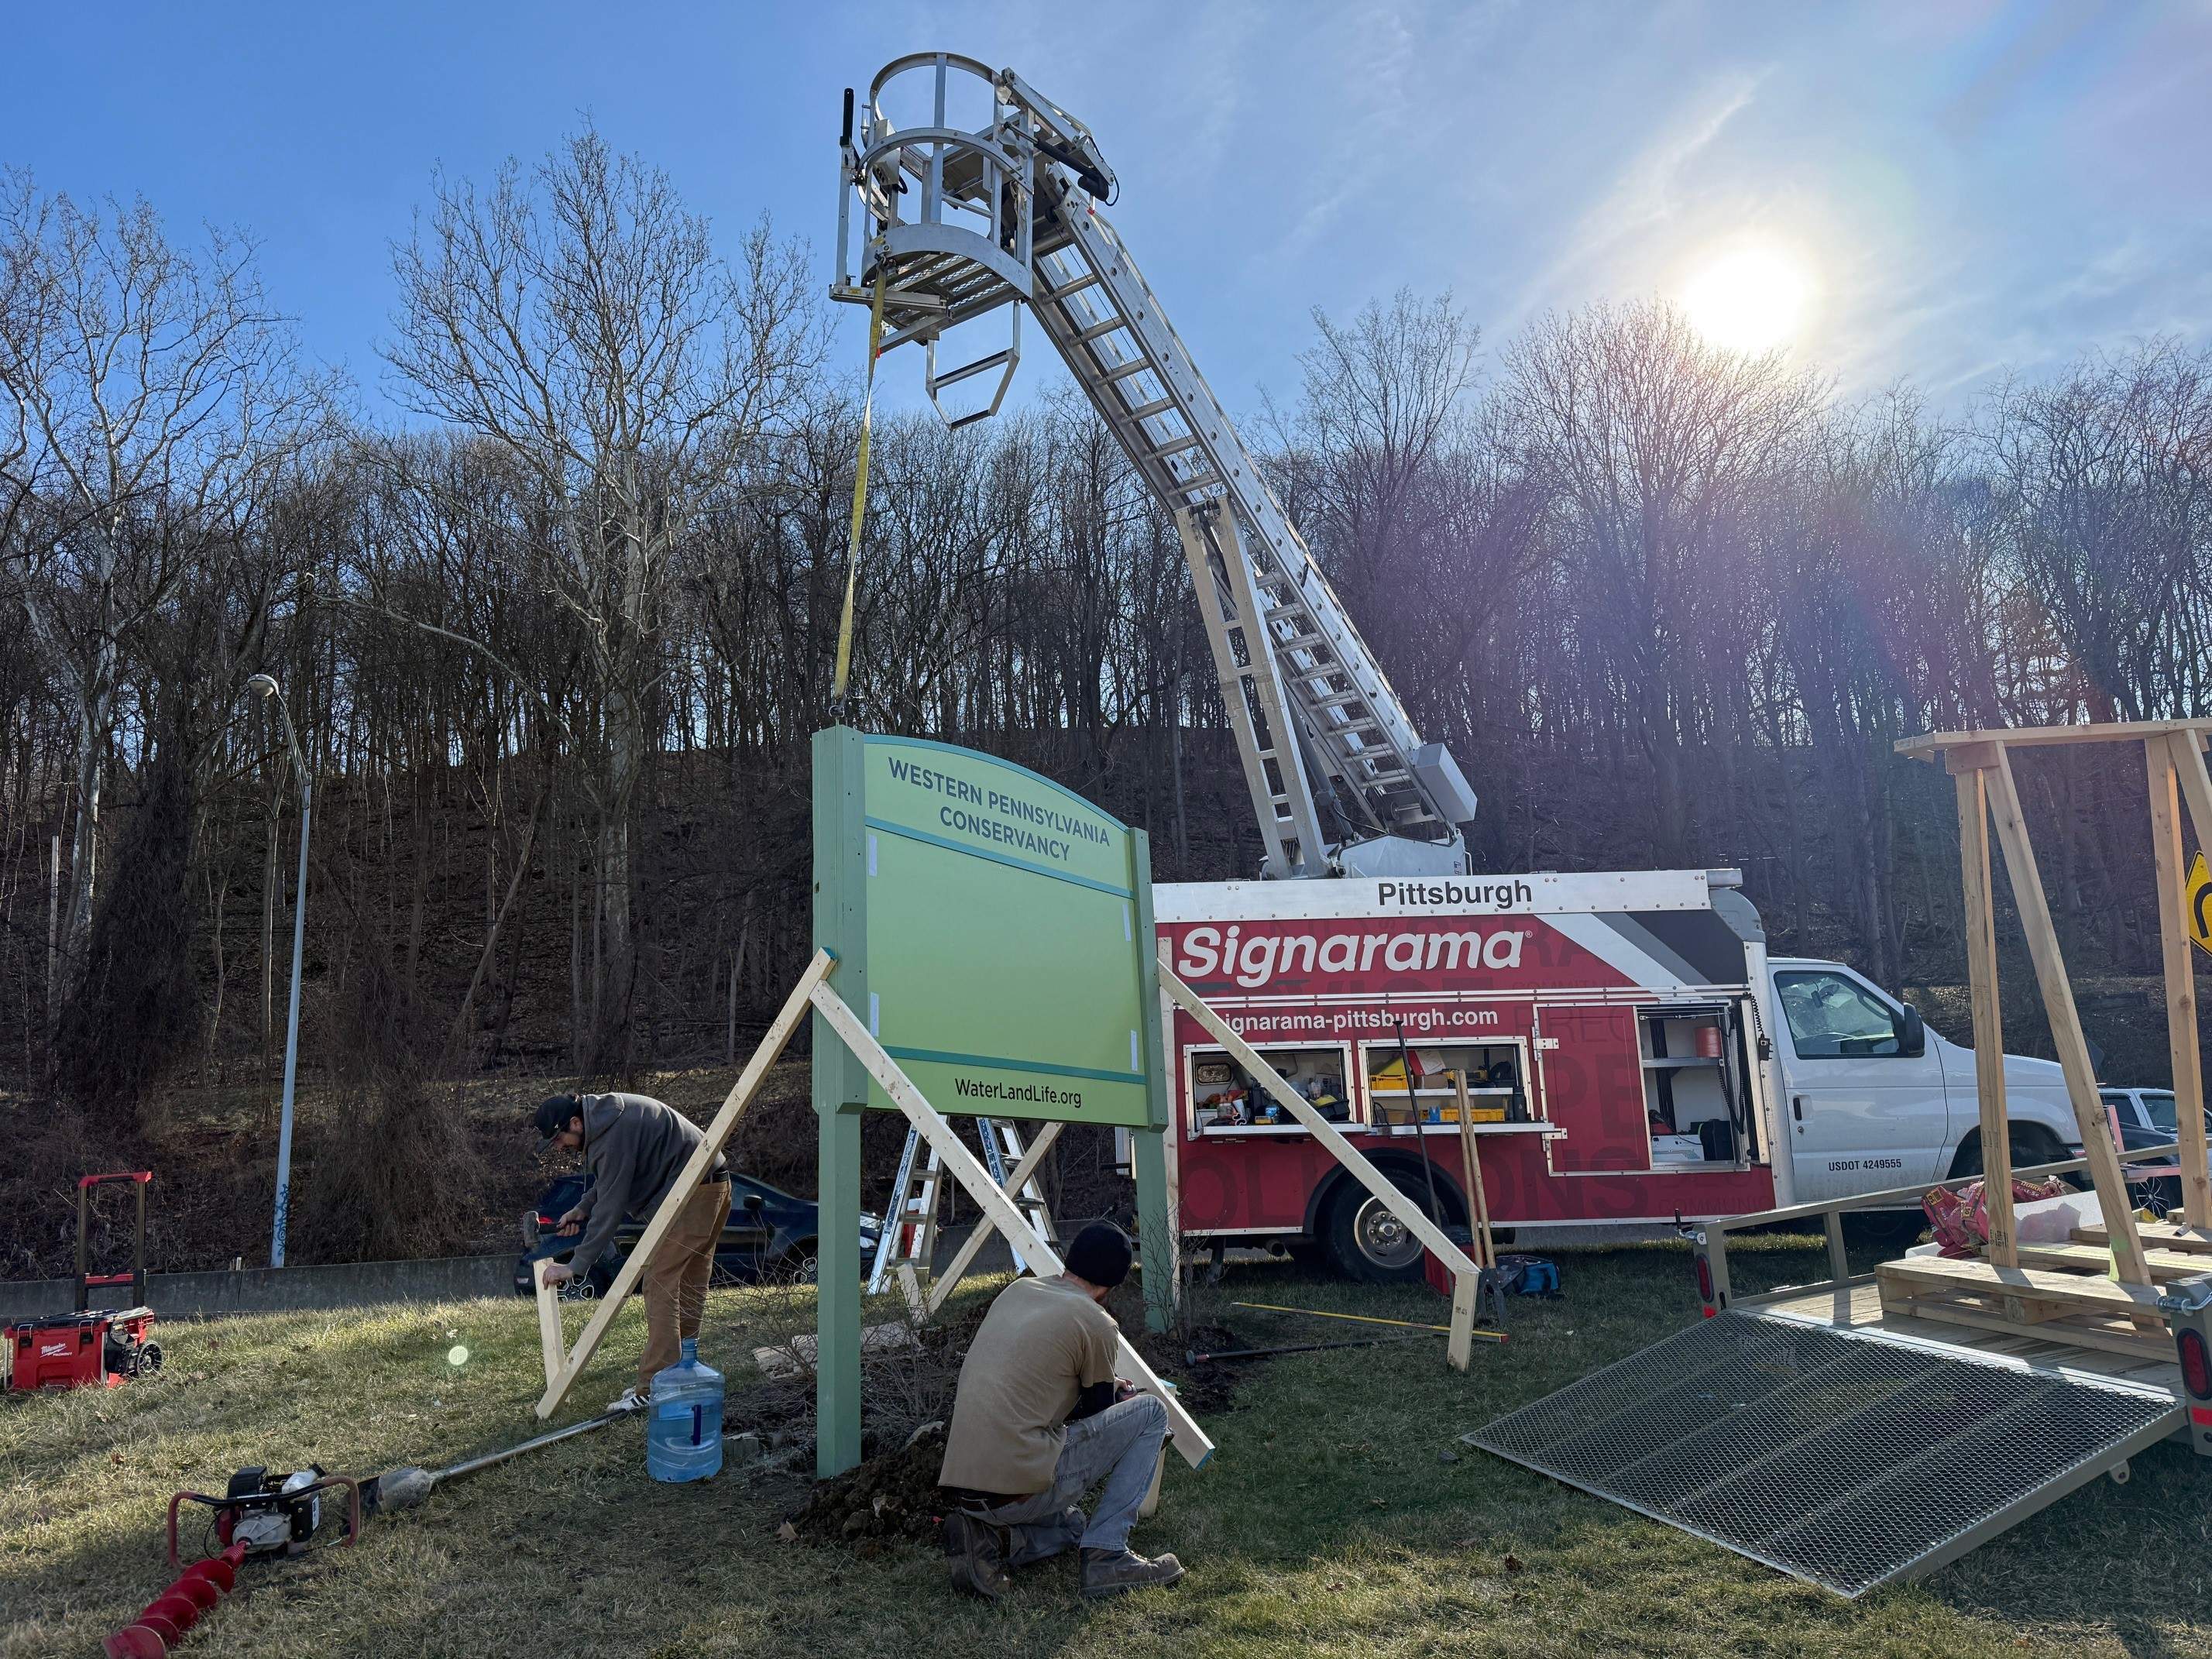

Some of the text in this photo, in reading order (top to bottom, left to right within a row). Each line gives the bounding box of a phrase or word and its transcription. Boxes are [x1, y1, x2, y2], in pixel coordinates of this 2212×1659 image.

[888, 757, 1111, 847] WESTERN PENNSYLVANIA
[939, 806, 1070, 861] CONSERVANCY
[1379, 880, 1533, 910] Pittsburgh
[1177, 925, 1523, 988] Signarama
[1224, 1008, 1499, 1036] ignarama-pittsburgh.com
[954, 1078, 1082, 1108] WaterLandLife.org
[1829, 1159, 1901, 1171] USDOT 4249555
